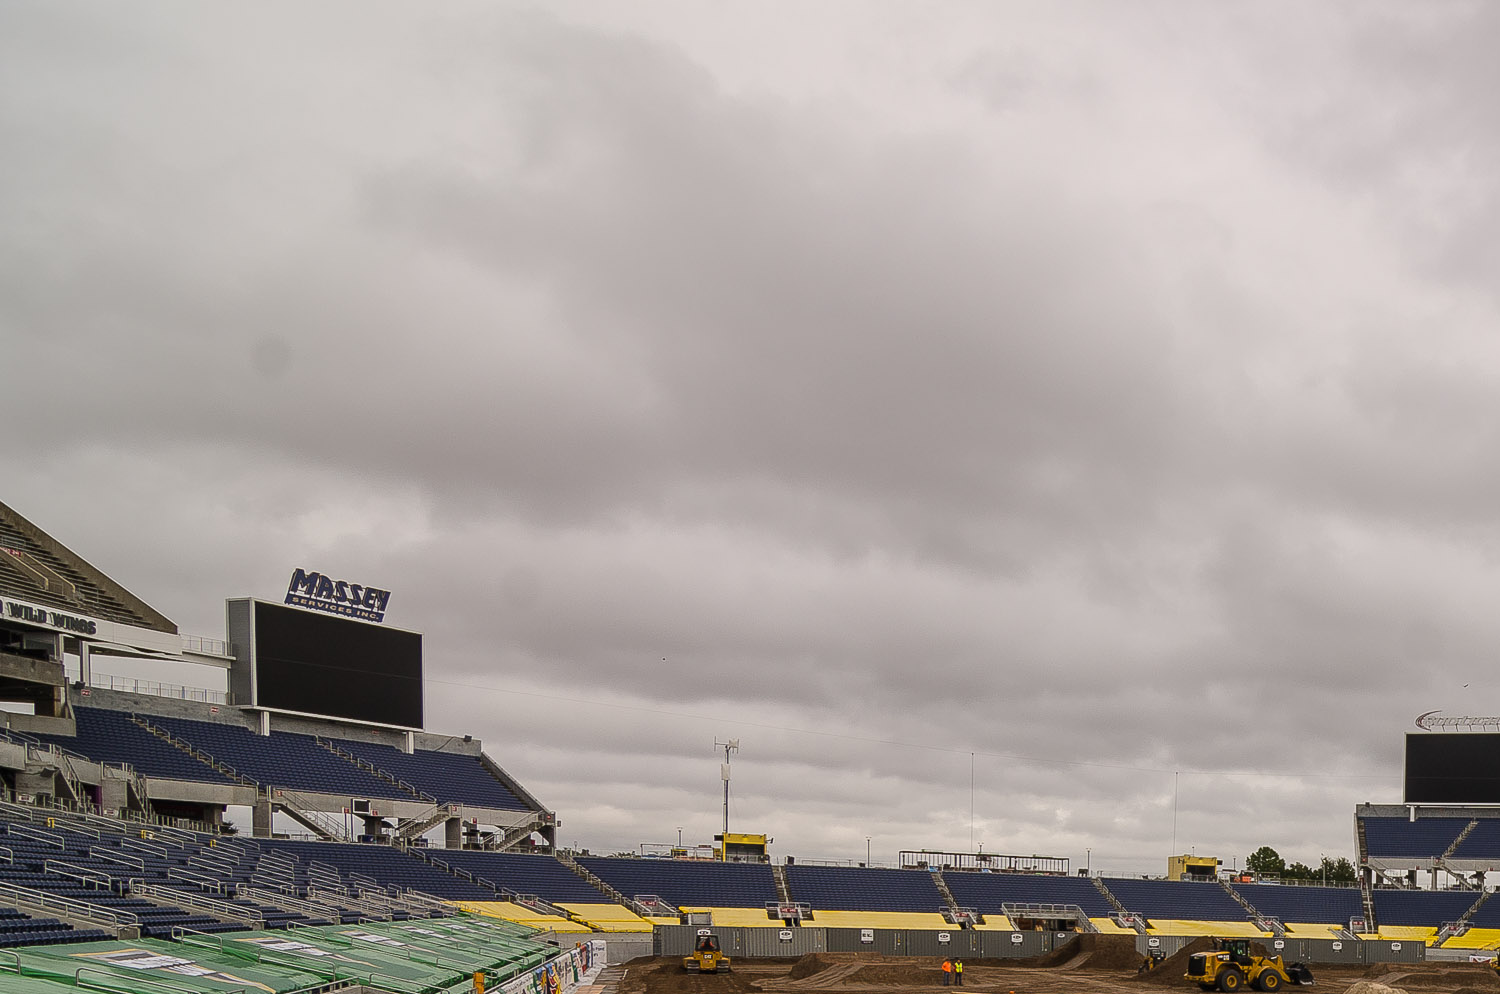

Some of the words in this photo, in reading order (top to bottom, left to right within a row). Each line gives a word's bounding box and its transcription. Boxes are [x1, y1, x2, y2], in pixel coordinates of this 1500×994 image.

[289, 567, 391, 612] MASSEY
[7, 601, 47, 623] WILD
[50, 612, 97, 635] WINGS
[292, 597, 353, 614] SERVICES
[356, 608, 380, 620] INC.
